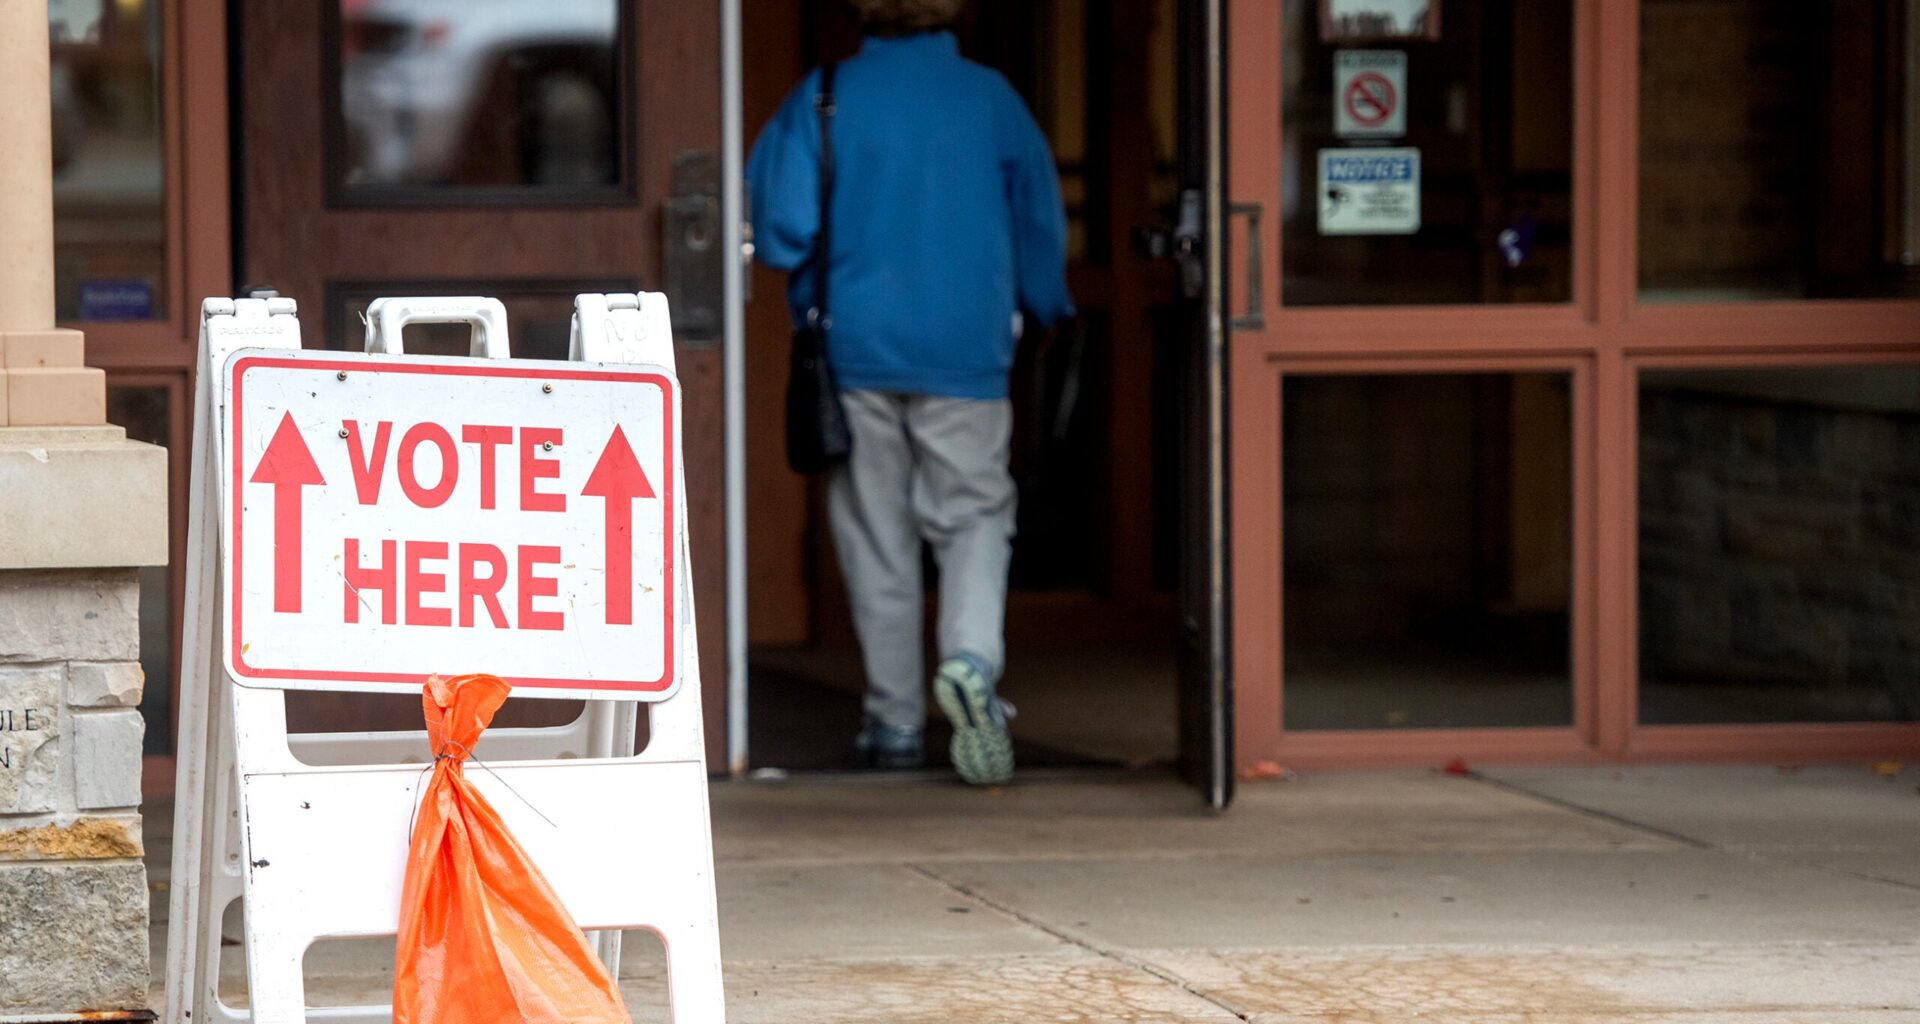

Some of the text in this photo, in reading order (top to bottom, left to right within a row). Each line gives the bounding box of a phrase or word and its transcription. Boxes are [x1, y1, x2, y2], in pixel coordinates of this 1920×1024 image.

[1330, 160, 1406, 178] NOTICE
[343, 419, 566, 513] VOTE
[344, 538, 565, 631] HERE
